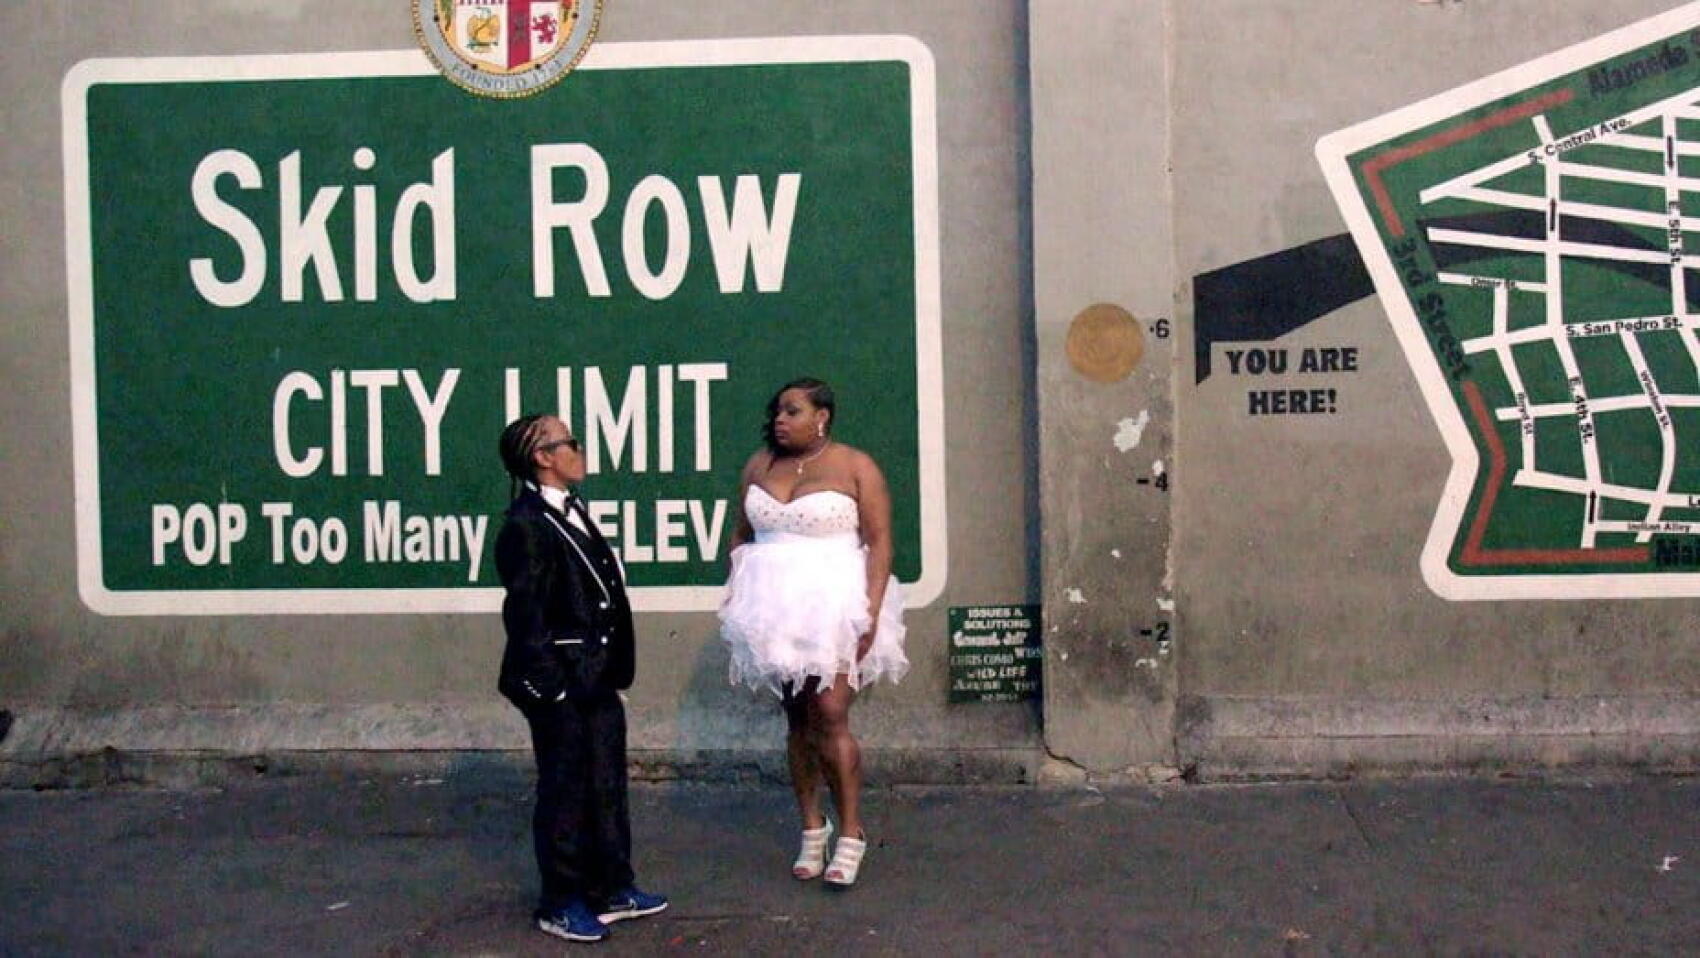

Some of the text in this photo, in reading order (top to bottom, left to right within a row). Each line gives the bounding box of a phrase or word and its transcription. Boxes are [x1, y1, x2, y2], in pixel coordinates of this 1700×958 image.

[1545, 127, 1596, 156] Central
[1600, 118, 1632, 137] Ave.
[190, 143, 802, 307] Skid Row
[1583, 322, 1611, 335] San
[1615, 318, 1659, 332] Pedro
[1663, 316, 1683, 328] St.
[1225, 348, 1359, 375] YOU ARE
[1249, 388, 1337, 415] HERE!
[1574, 395, 1587, 418] 4th
[273, 367, 461, 477] CITY
[152, 503, 247, 566] POP
[262, 501, 348, 563] Too
[364, 500, 488, 582] Many
[1663, 521, 1691, 534] Alley
